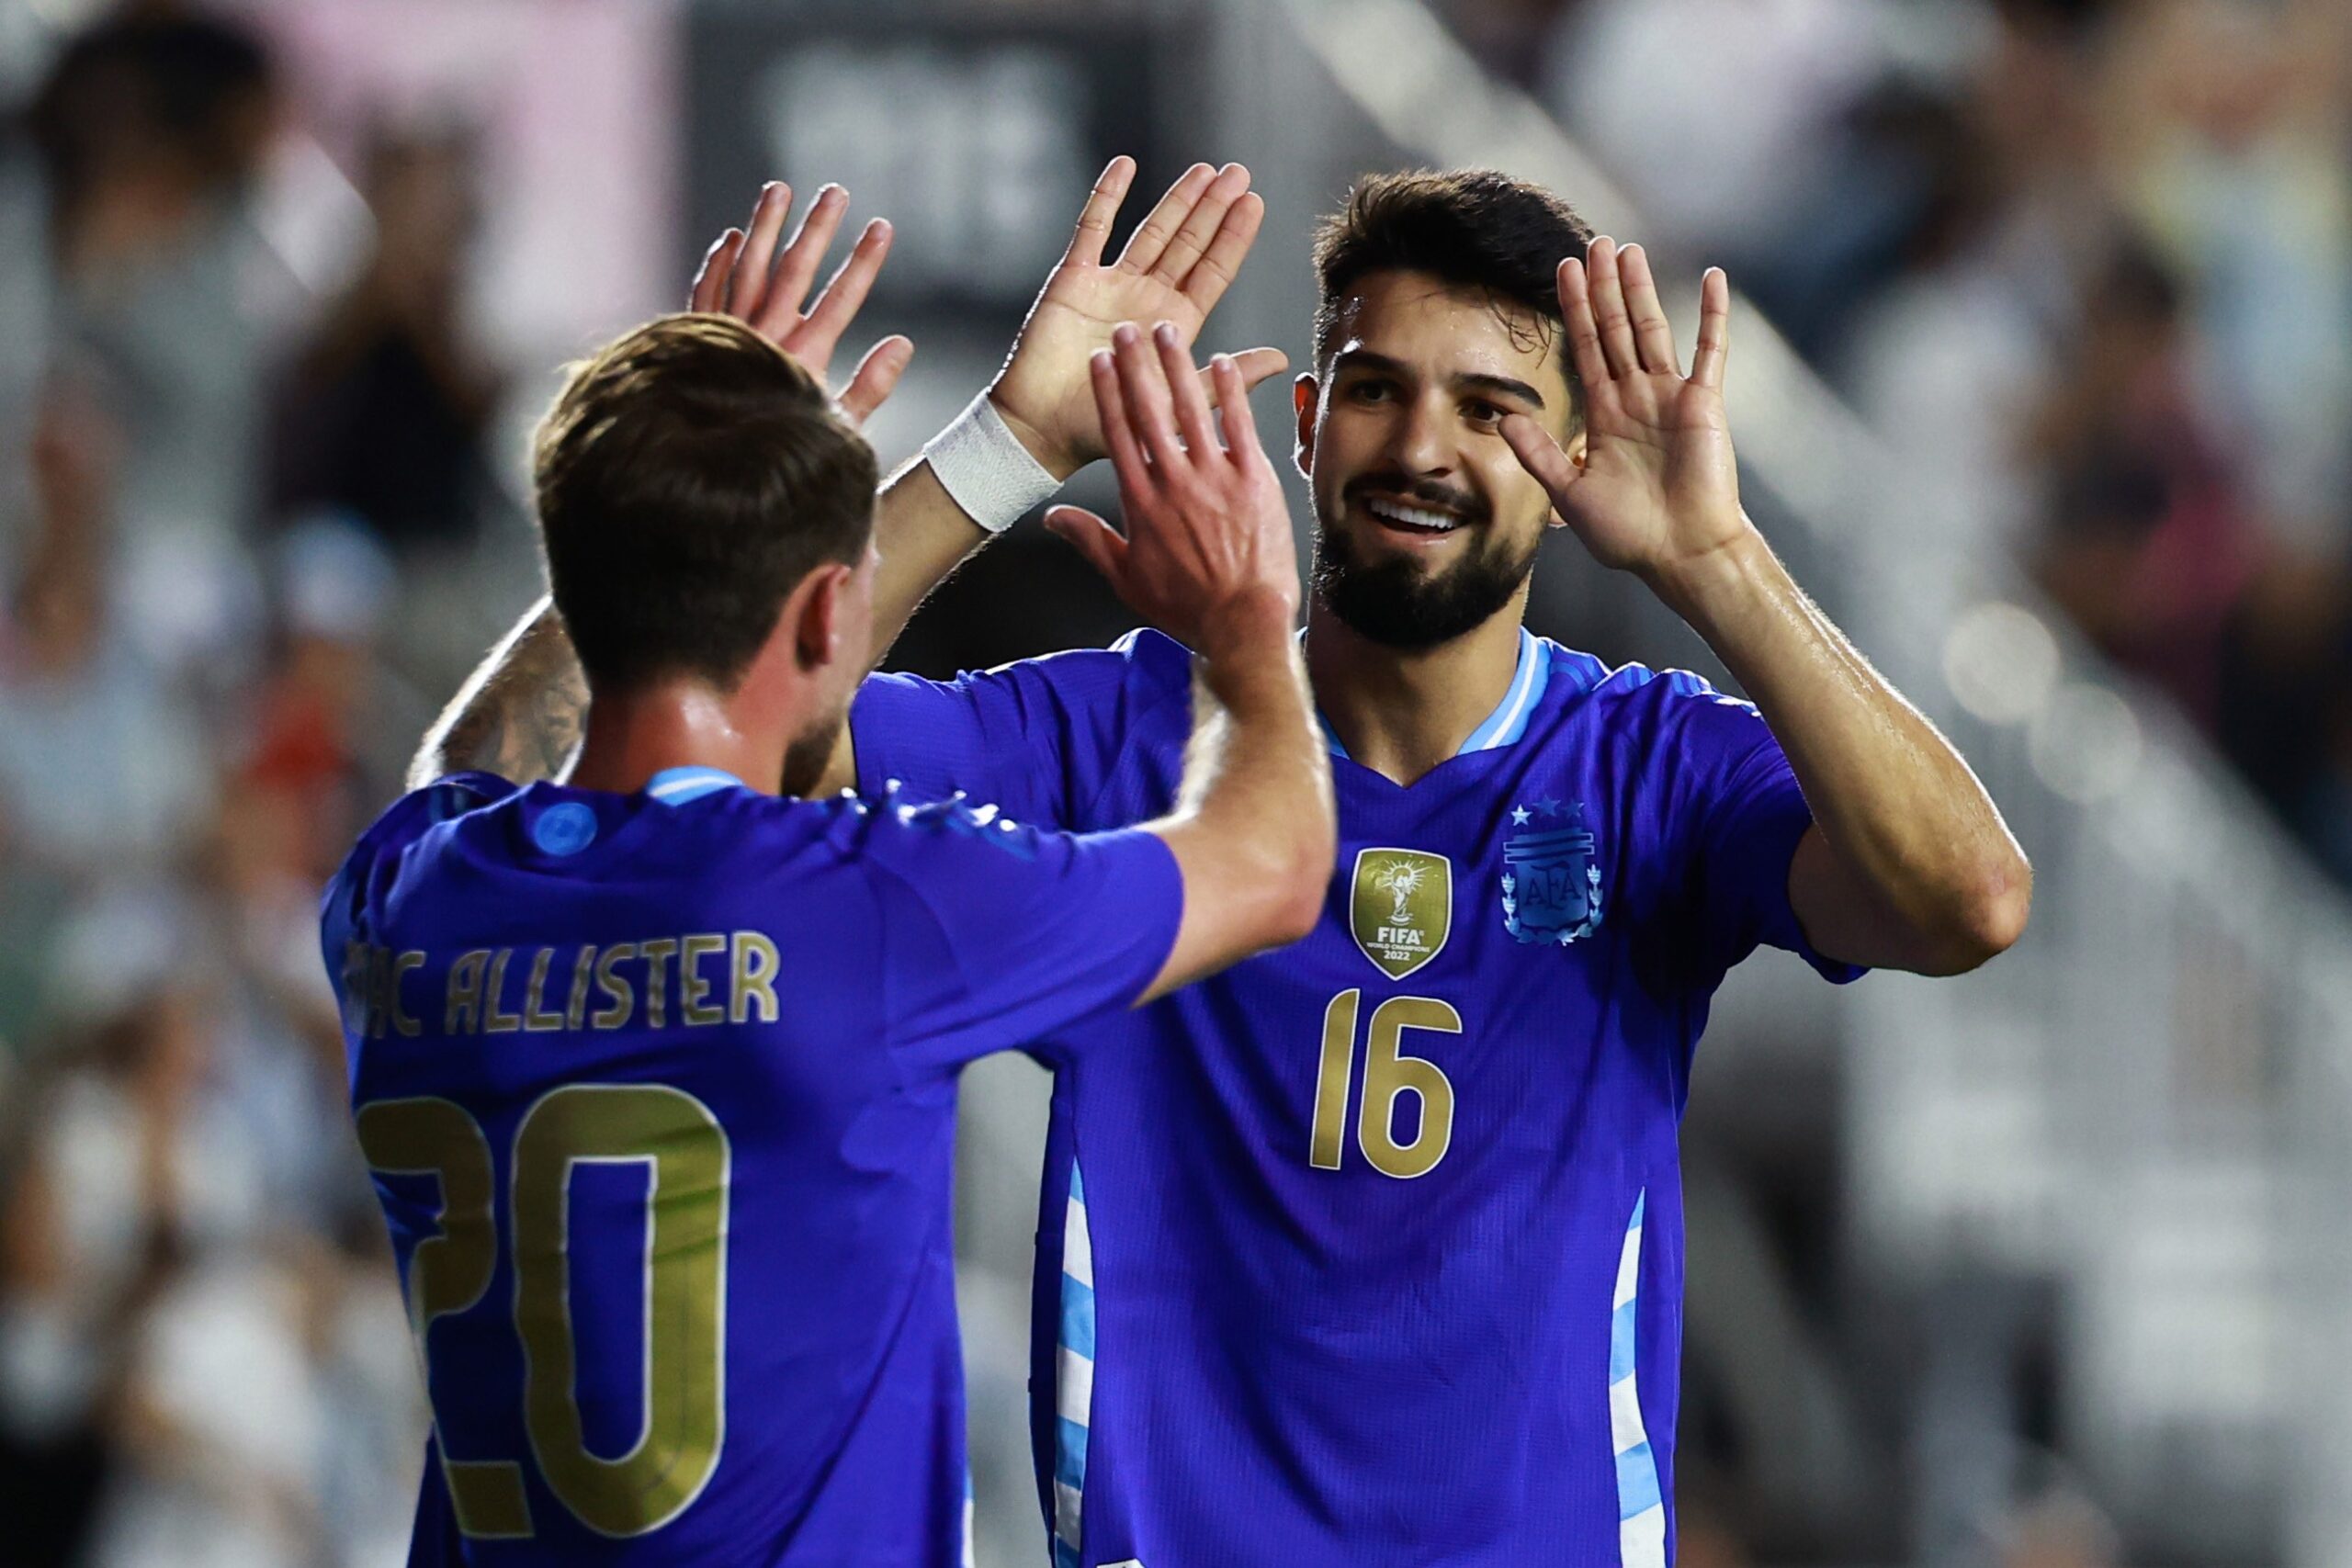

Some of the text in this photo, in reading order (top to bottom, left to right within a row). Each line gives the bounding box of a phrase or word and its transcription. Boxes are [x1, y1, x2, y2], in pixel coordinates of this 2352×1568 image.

[1523, 861, 1582, 910] AFA
[1377, 926, 1420, 944] FIFA
[1384, 950, 1410, 961] 2022
[445, 931, 780, 1035] ALLISTER
[1309, 987, 1463, 1179] 16
[356, 1082, 731, 1539] 20
